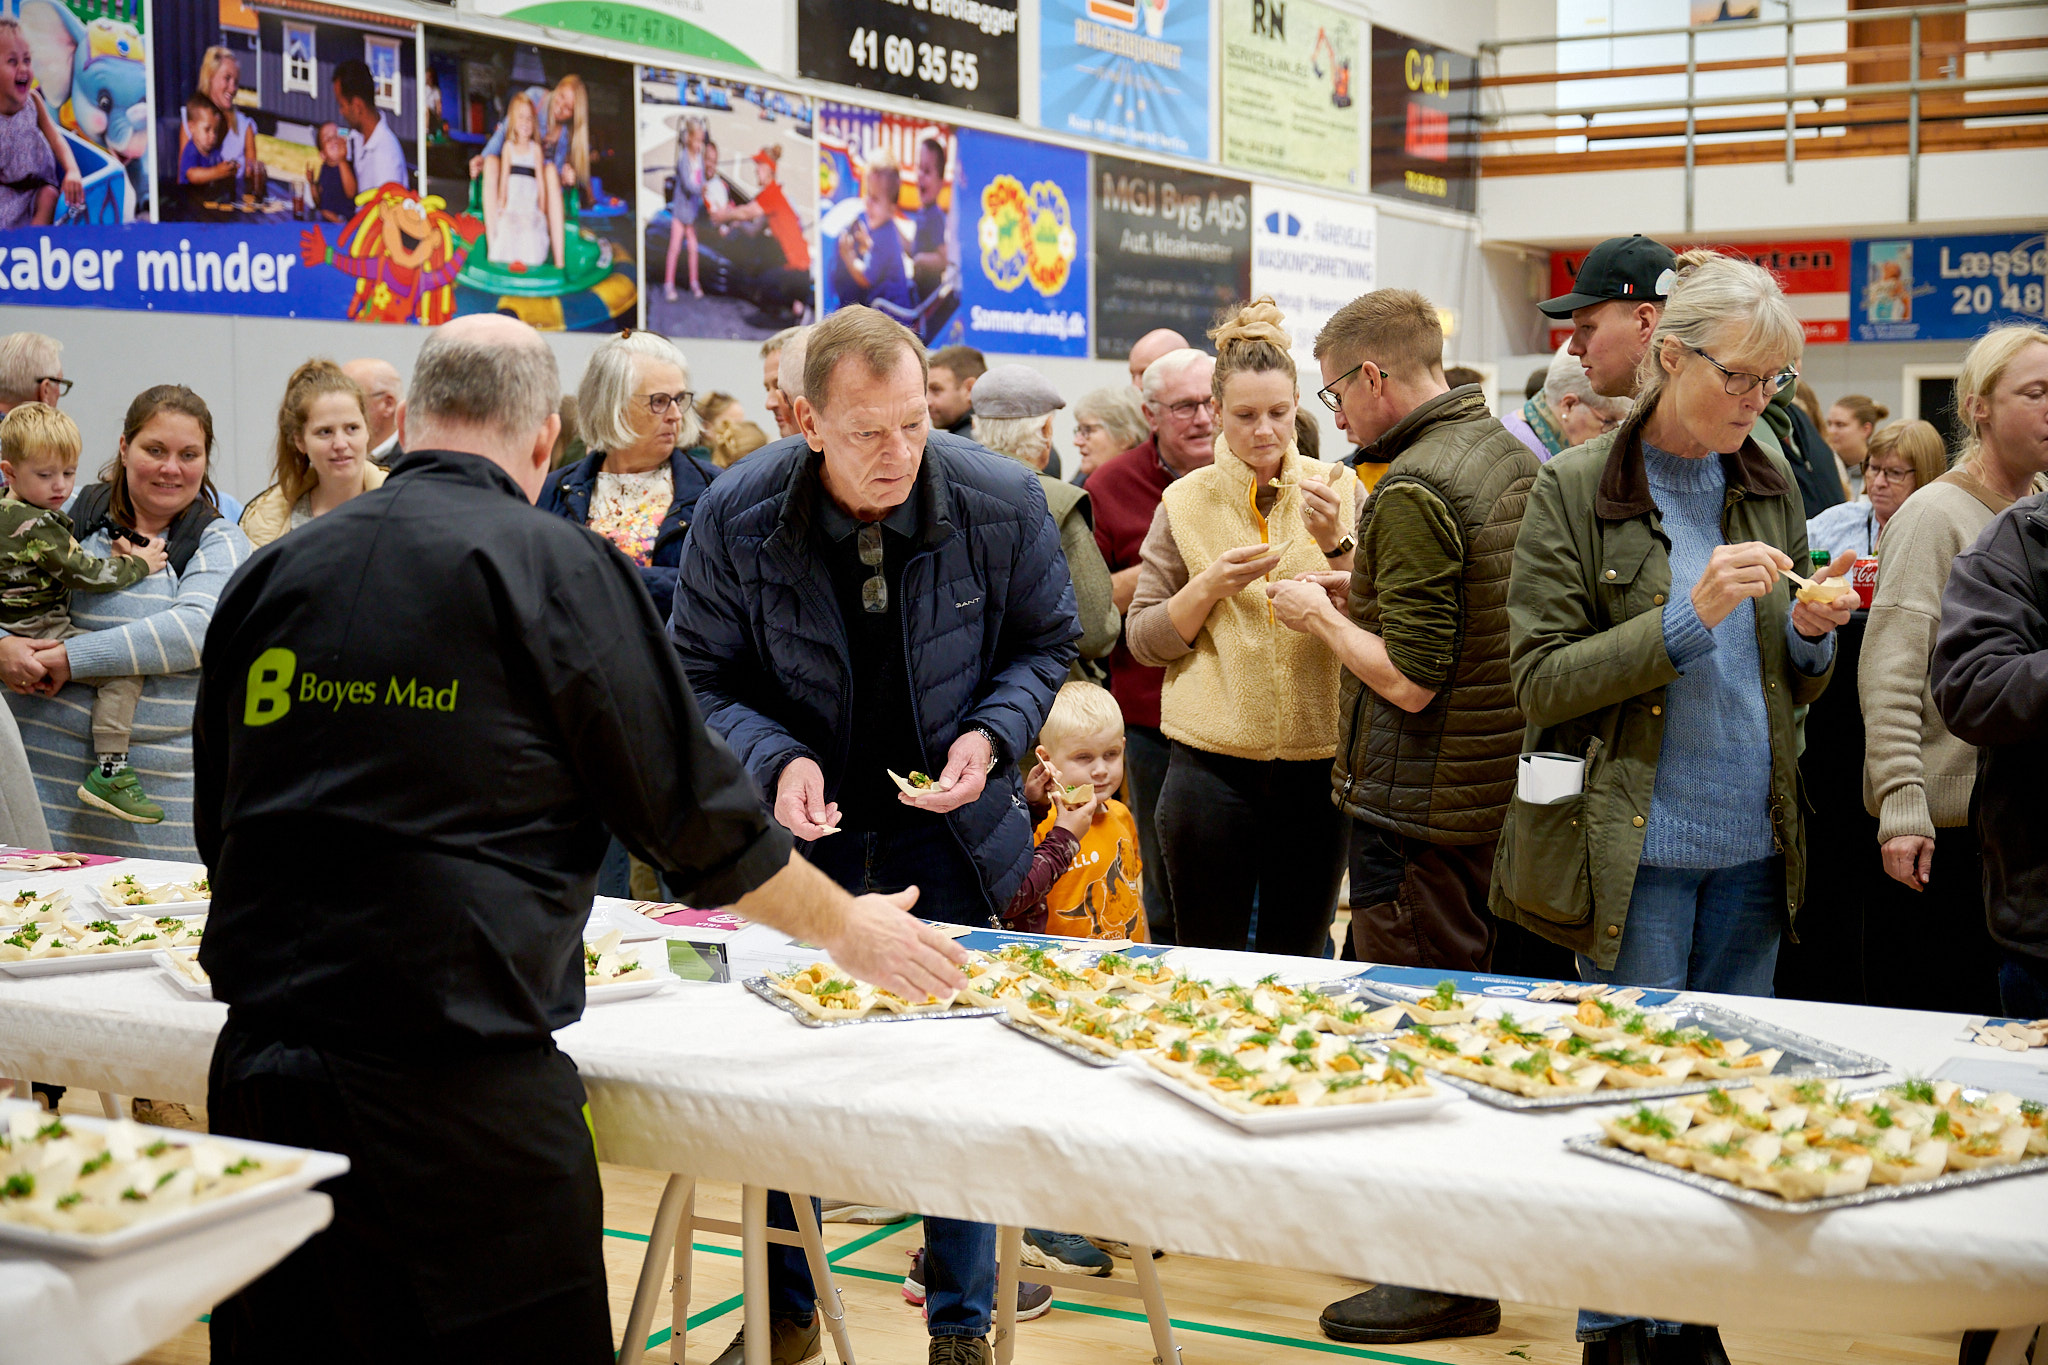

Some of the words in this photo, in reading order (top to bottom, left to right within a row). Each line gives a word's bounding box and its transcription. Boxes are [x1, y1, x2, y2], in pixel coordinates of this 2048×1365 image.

[591, 7, 613, 29] 29
[615, 13, 637, 36] 47
[640, 18, 661, 42] 47
[1252, 0, 1286, 42] RN
[849, 27, 878, 70] 41
[884, 34, 914, 77] 60
[917, 42, 947, 84] 35
[950, 50, 979, 91] 55
[1405, 48, 1450, 99] C&J
[1102, 171, 1156, 218] MGJ
[1160, 182, 1203, 232] Byg
[1205, 190, 1247, 236] ApS
[1119, 228, 1150, 255] Aut.
[137, 238, 296, 293] minder
[1952, 284, 1993, 315] 20
[2001, 283, 2043, 313] 48
[299, 672, 377, 713] Boyes
[384, 674, 459, 713] Mad
[1068, 851, 1099, 871] LLO
